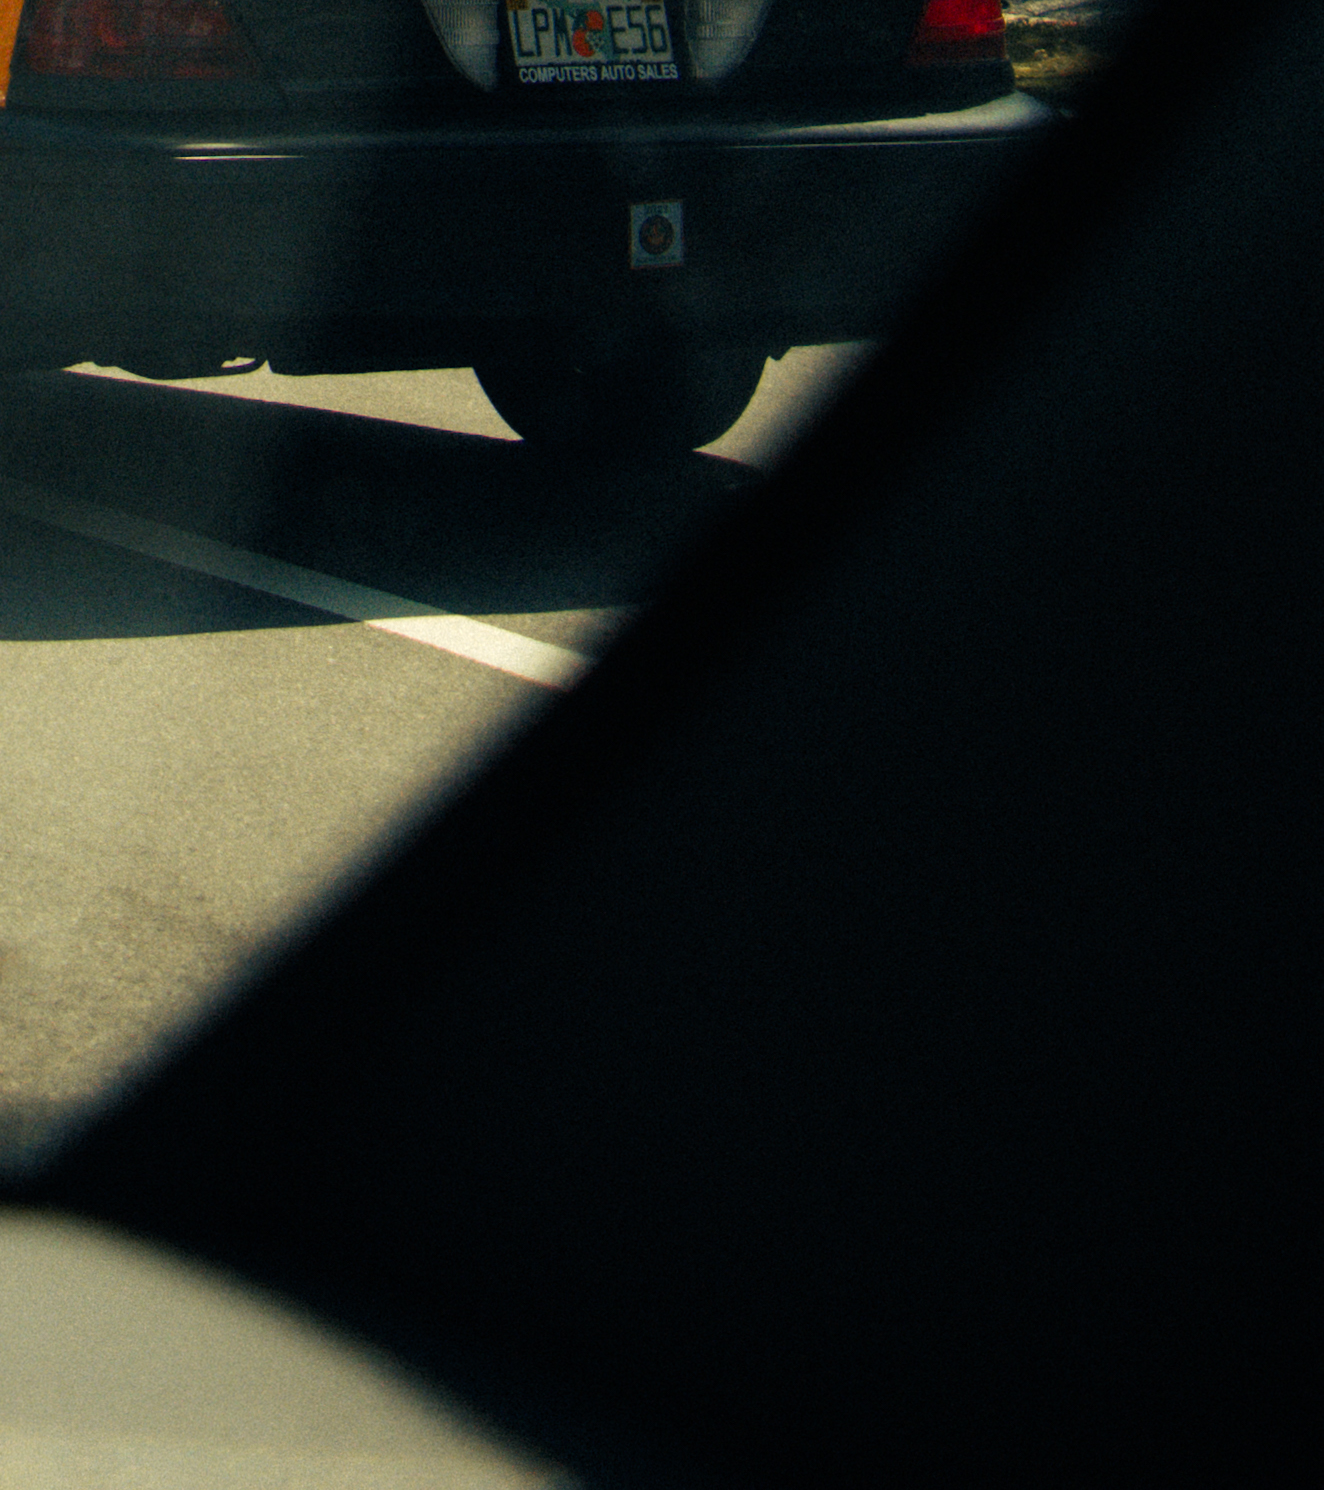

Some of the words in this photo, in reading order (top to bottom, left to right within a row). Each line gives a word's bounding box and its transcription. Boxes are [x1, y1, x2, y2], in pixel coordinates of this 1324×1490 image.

[606, 4, 668, 54] E56
[519, 66, 598, 83] COMPUTERS
[600, 65, 636, 81] AUTO
[637, 63, 679, 80] SALES
